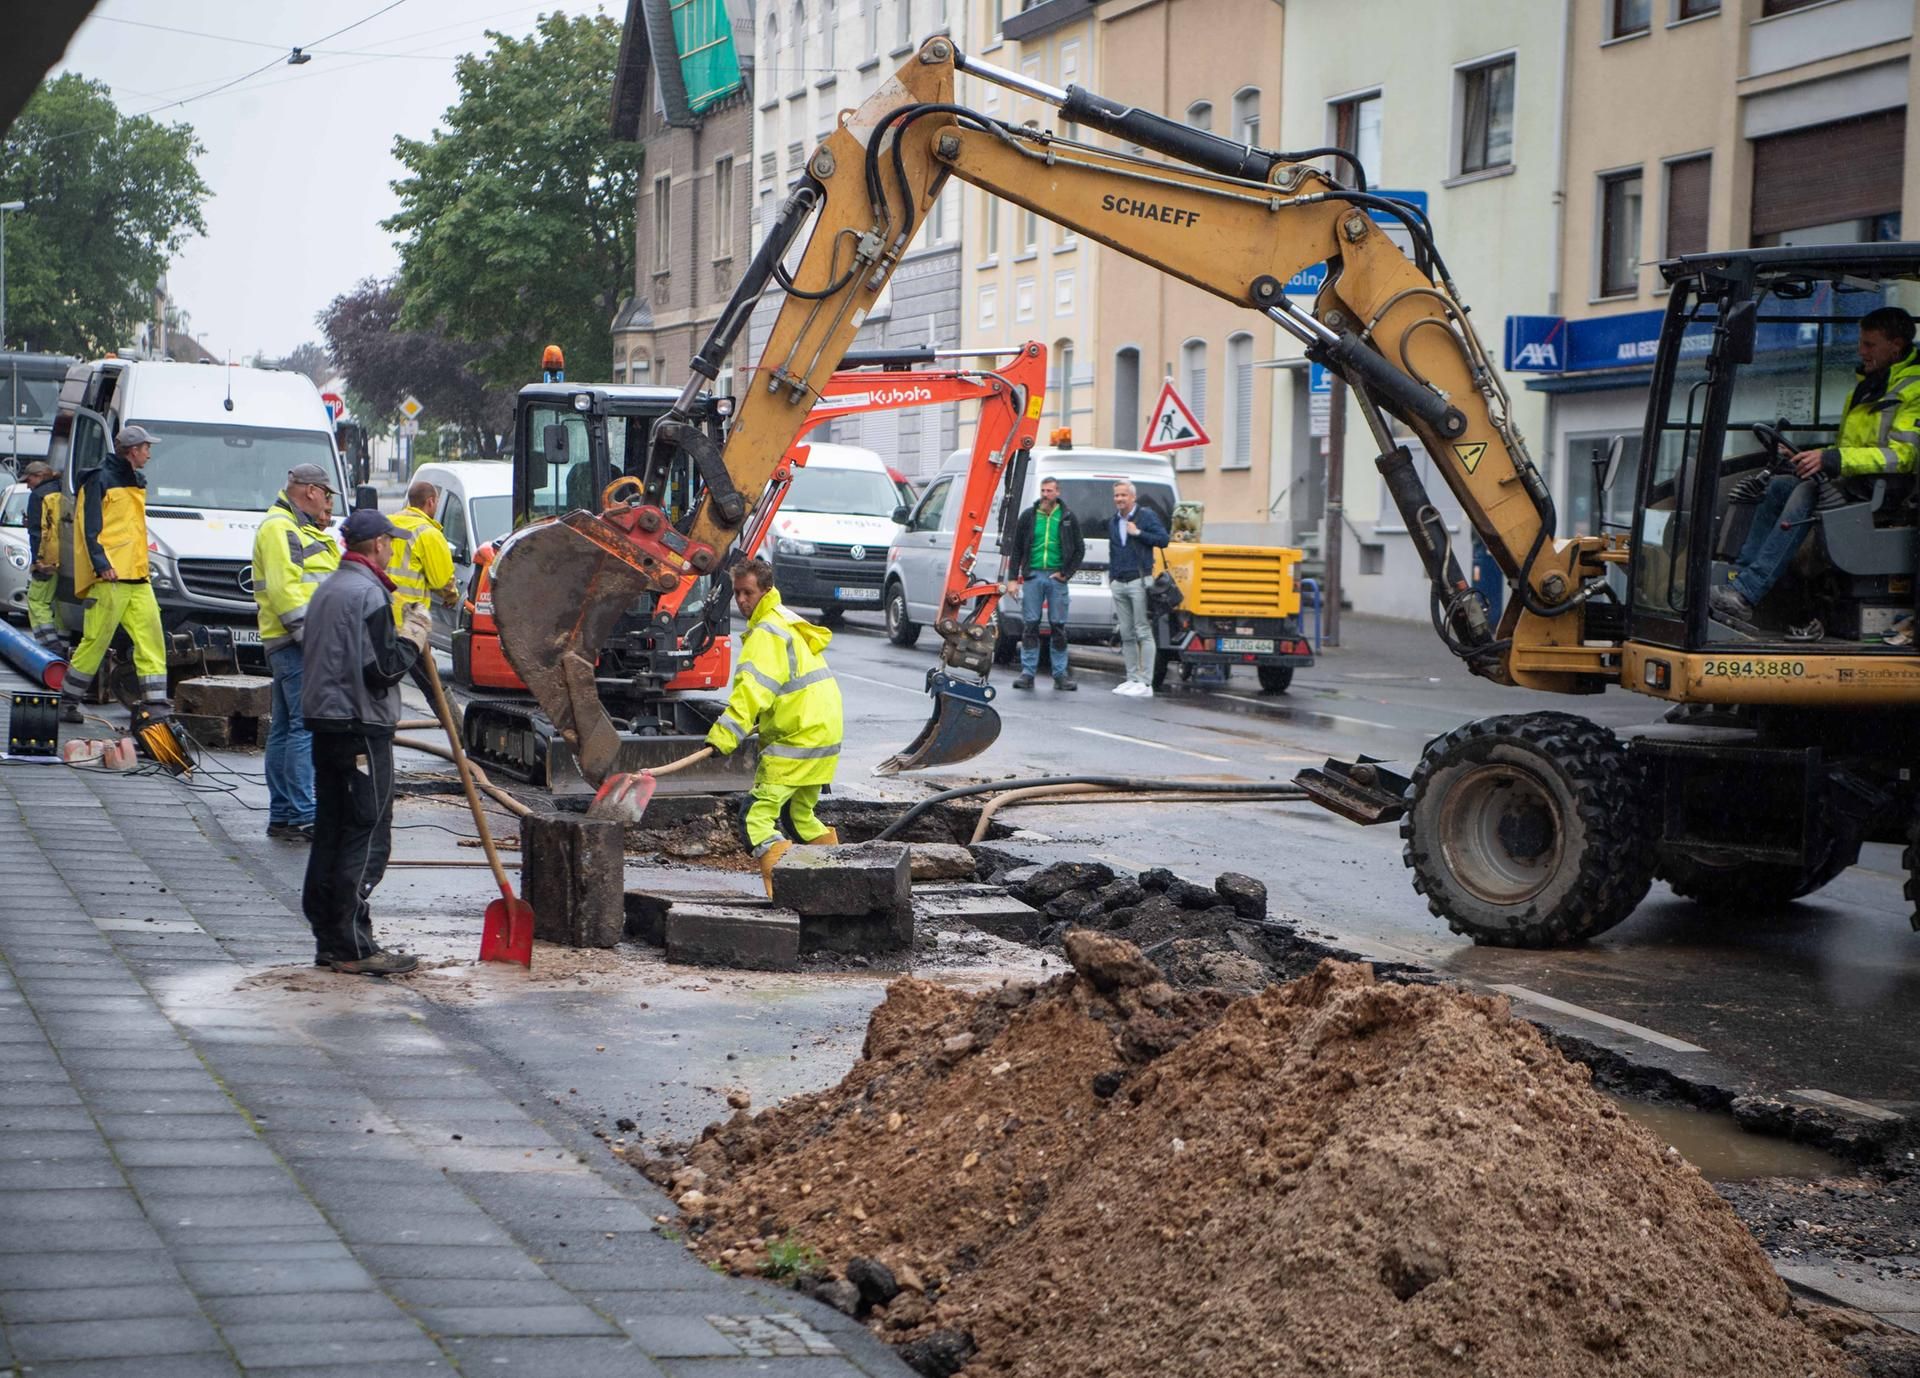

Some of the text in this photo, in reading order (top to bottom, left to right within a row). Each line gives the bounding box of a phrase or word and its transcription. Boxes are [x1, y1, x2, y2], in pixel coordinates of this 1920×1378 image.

[1101, 194, 1201, 228] SCHAEFF
[1514, 342, 1558, 366] AXA
[869, 385, 932, 405] Kubota
[1223, 639, 1235, 650] EU
[1255, 640, 1273, 651] 464
[1704, 661, 1805, 677] 26943880
